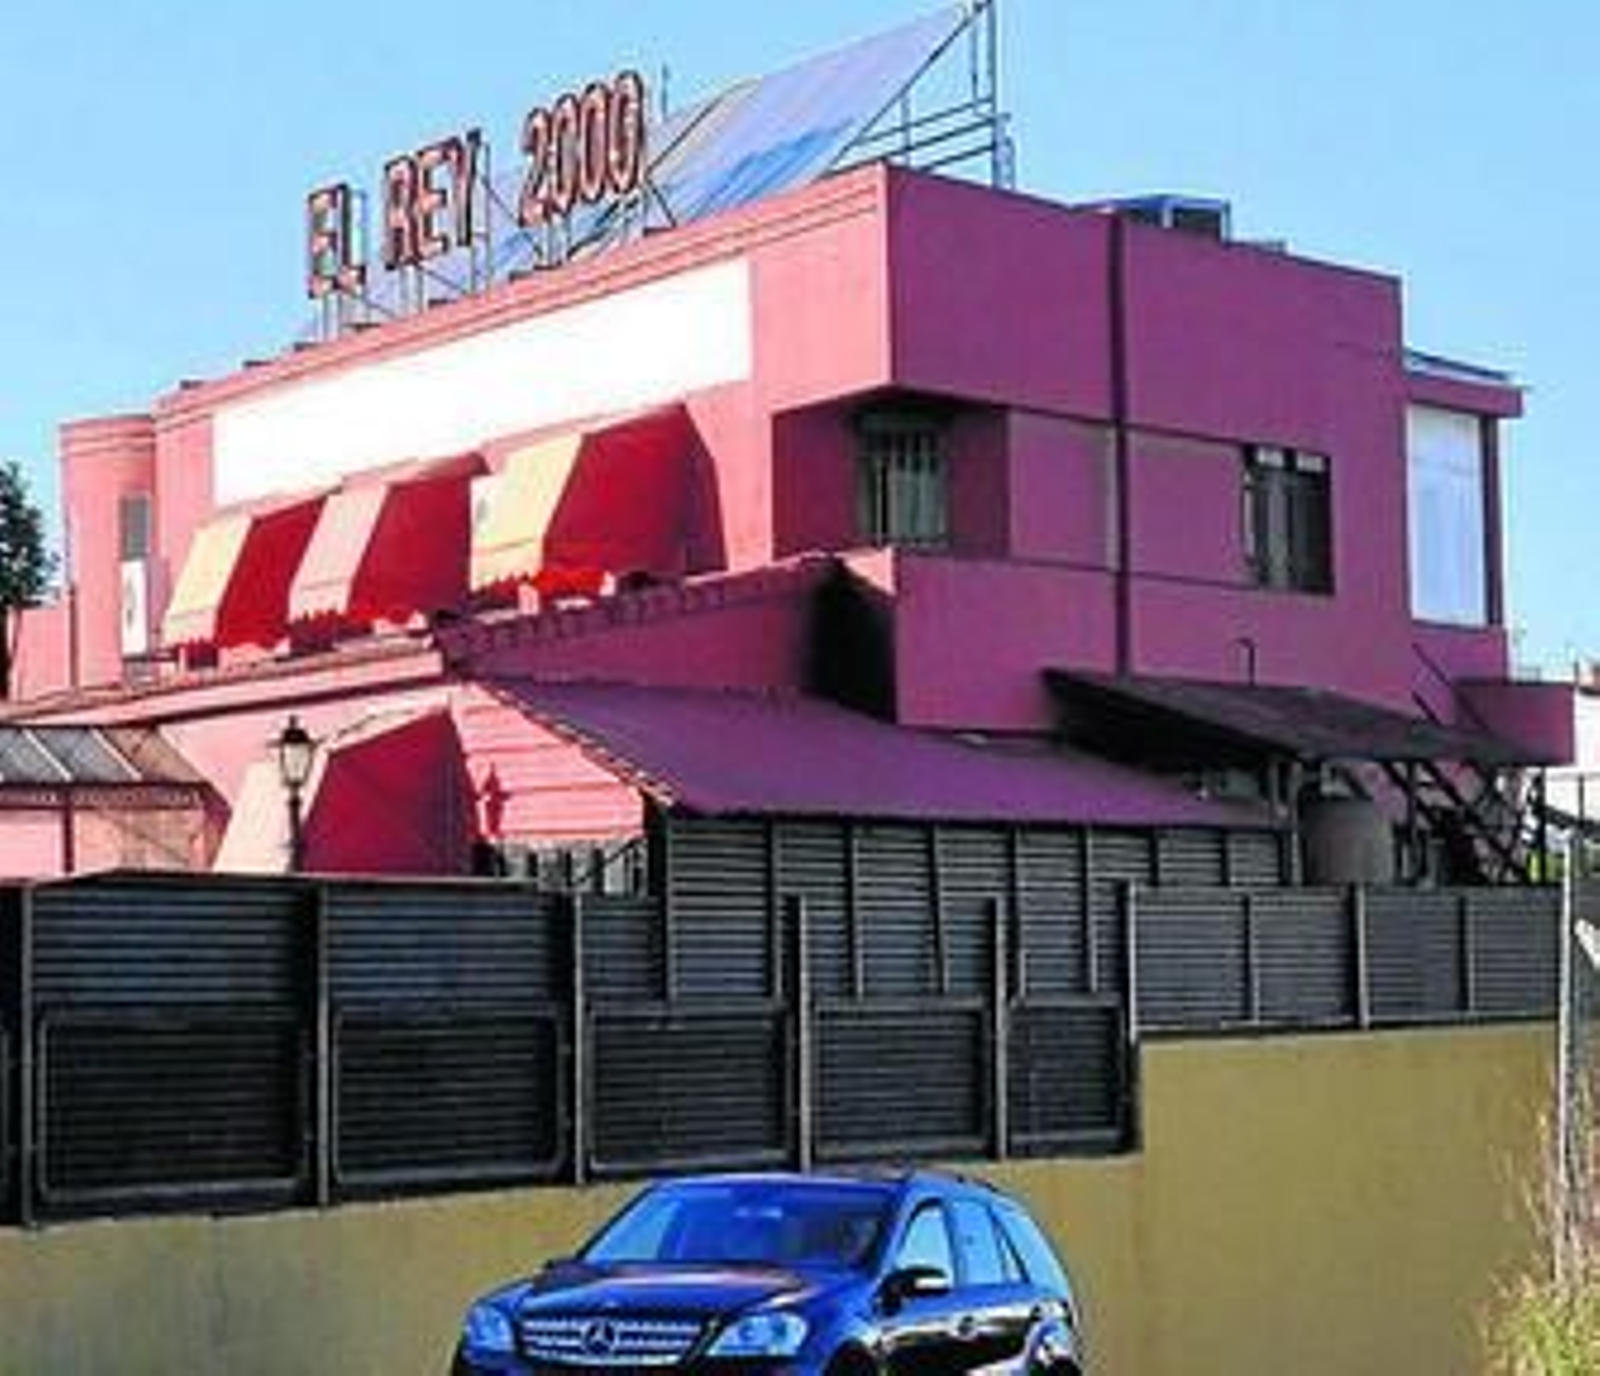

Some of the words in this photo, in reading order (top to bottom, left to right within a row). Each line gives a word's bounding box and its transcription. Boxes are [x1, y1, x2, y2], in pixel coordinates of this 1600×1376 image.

[308, 183, 366, 298] EL
[384, 128, 482, 271] REY
[517, 69, 645, 228] 2000
